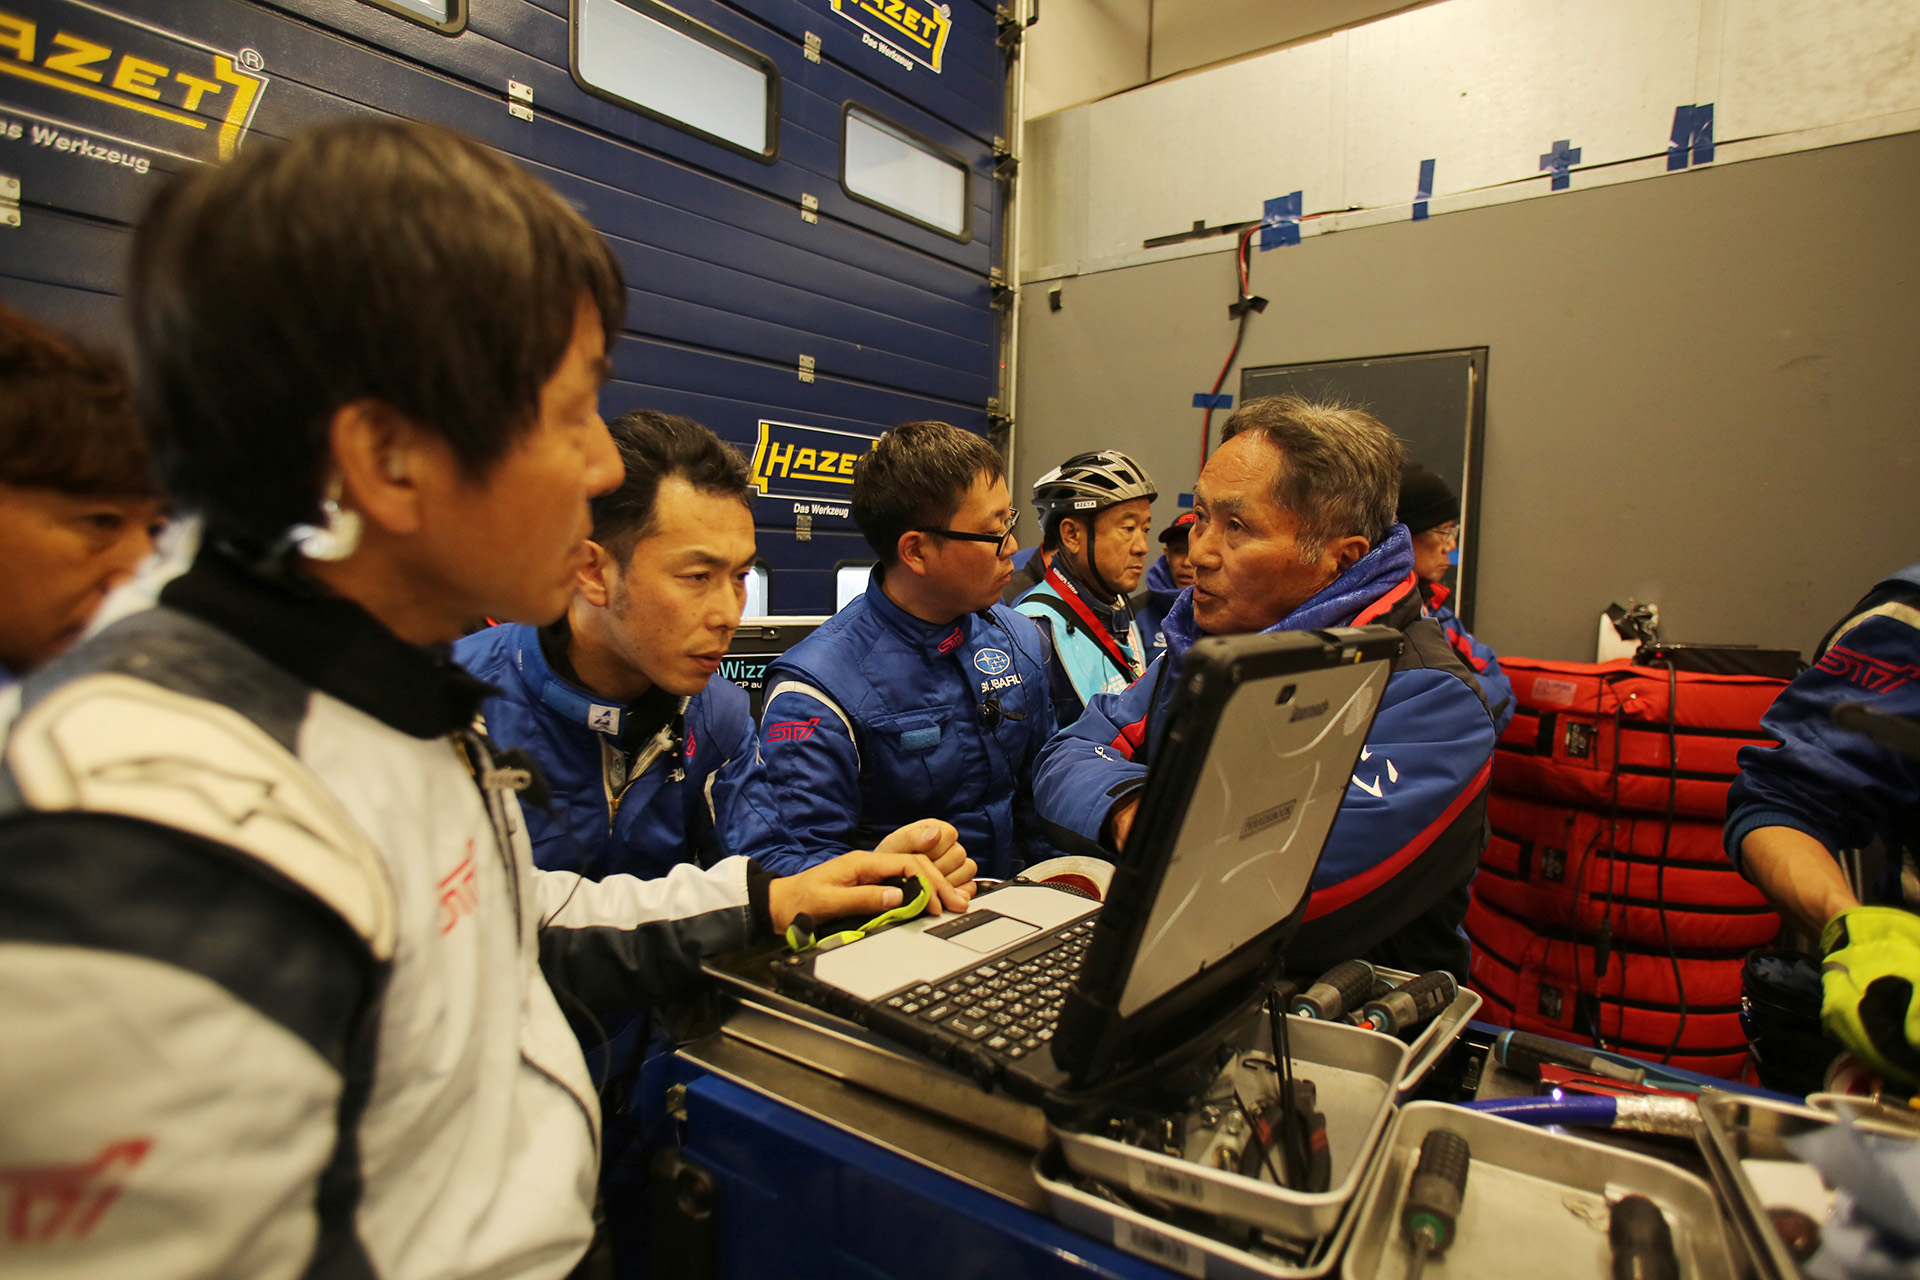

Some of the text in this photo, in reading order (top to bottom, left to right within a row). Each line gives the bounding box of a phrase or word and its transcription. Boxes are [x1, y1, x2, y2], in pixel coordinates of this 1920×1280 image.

[851, 0, 938, 39] ZET
[862, 33, 914, 71] Das Werkzeug
[31, 124, 151, 174] Werkzeug
[765, 442, 865, 478] HAZE
[793, 502, 849, 519] Das Werkzeug
[717, 660, 767, 679] Wizz
[981, 672, 1023, 694] SUBARU
